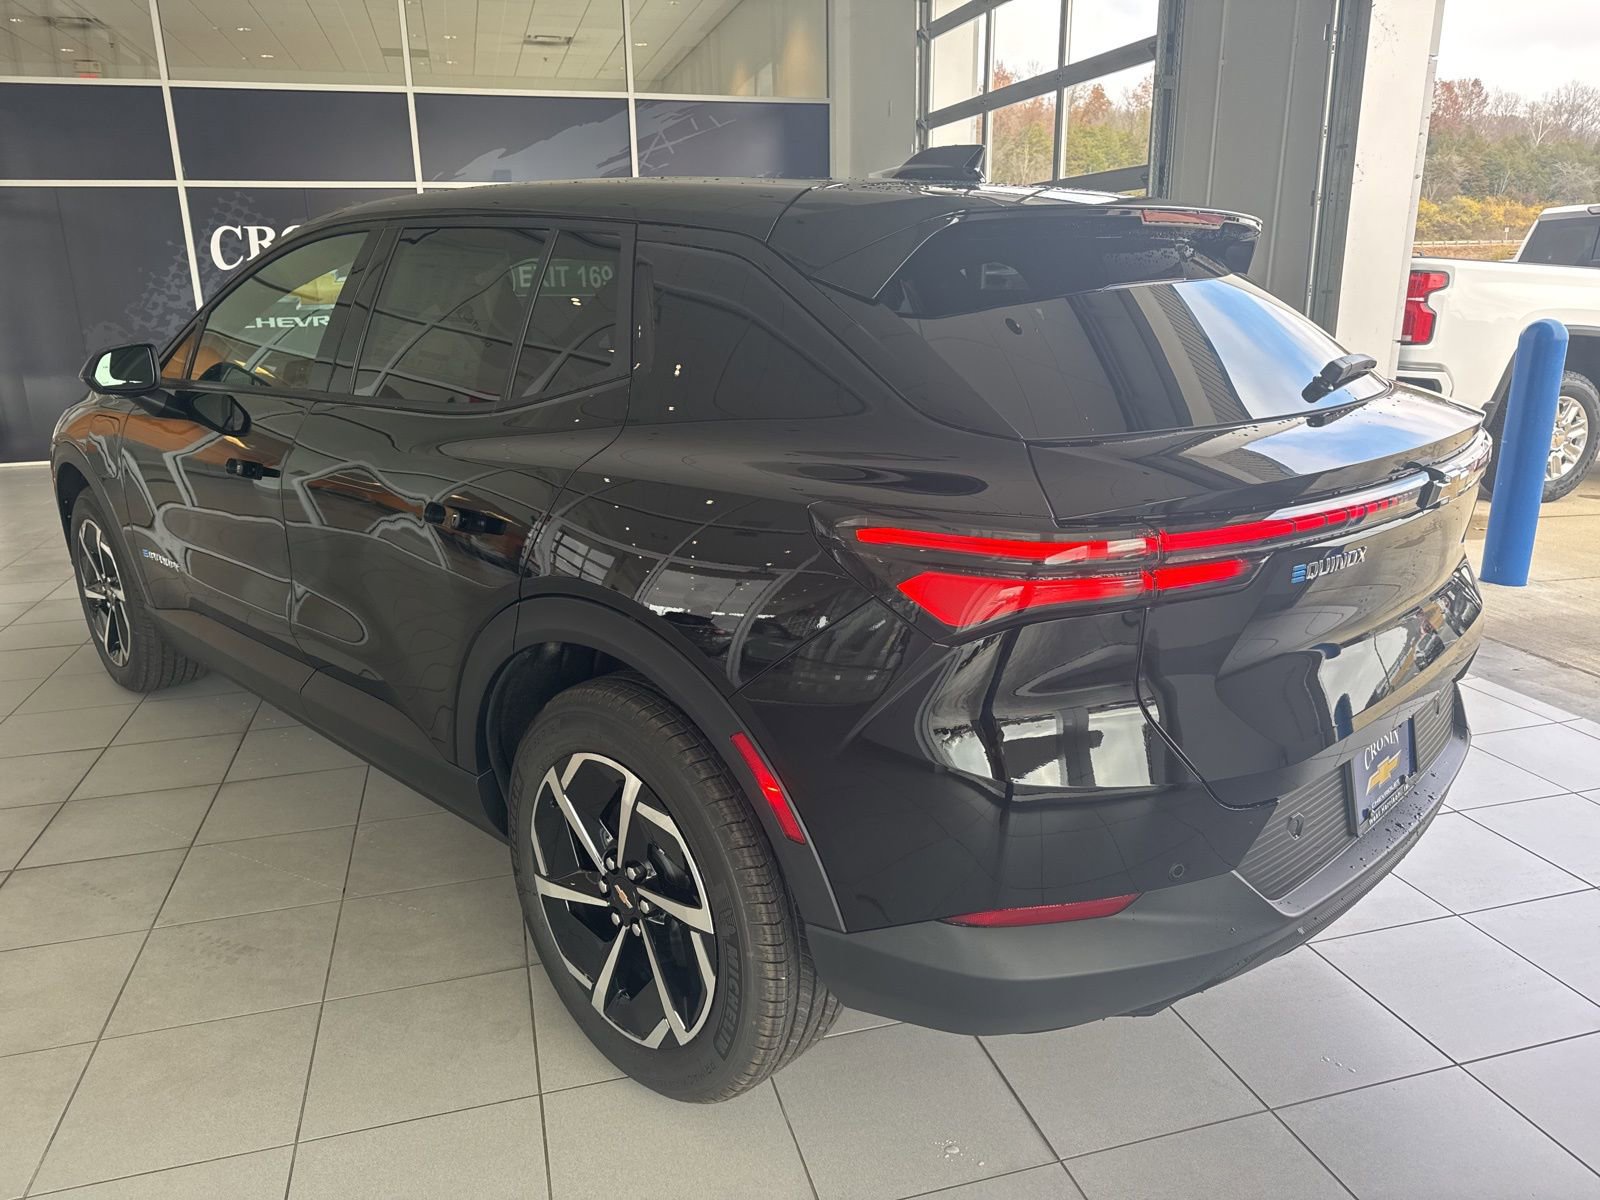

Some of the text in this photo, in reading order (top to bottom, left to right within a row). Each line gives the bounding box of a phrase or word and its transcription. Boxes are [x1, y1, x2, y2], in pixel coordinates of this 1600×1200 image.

[210, 225, 300, 271] CR
[1291, 546, 1367, 584] EQUINOX
[1364, 730, 1399, 770] CRONIN
